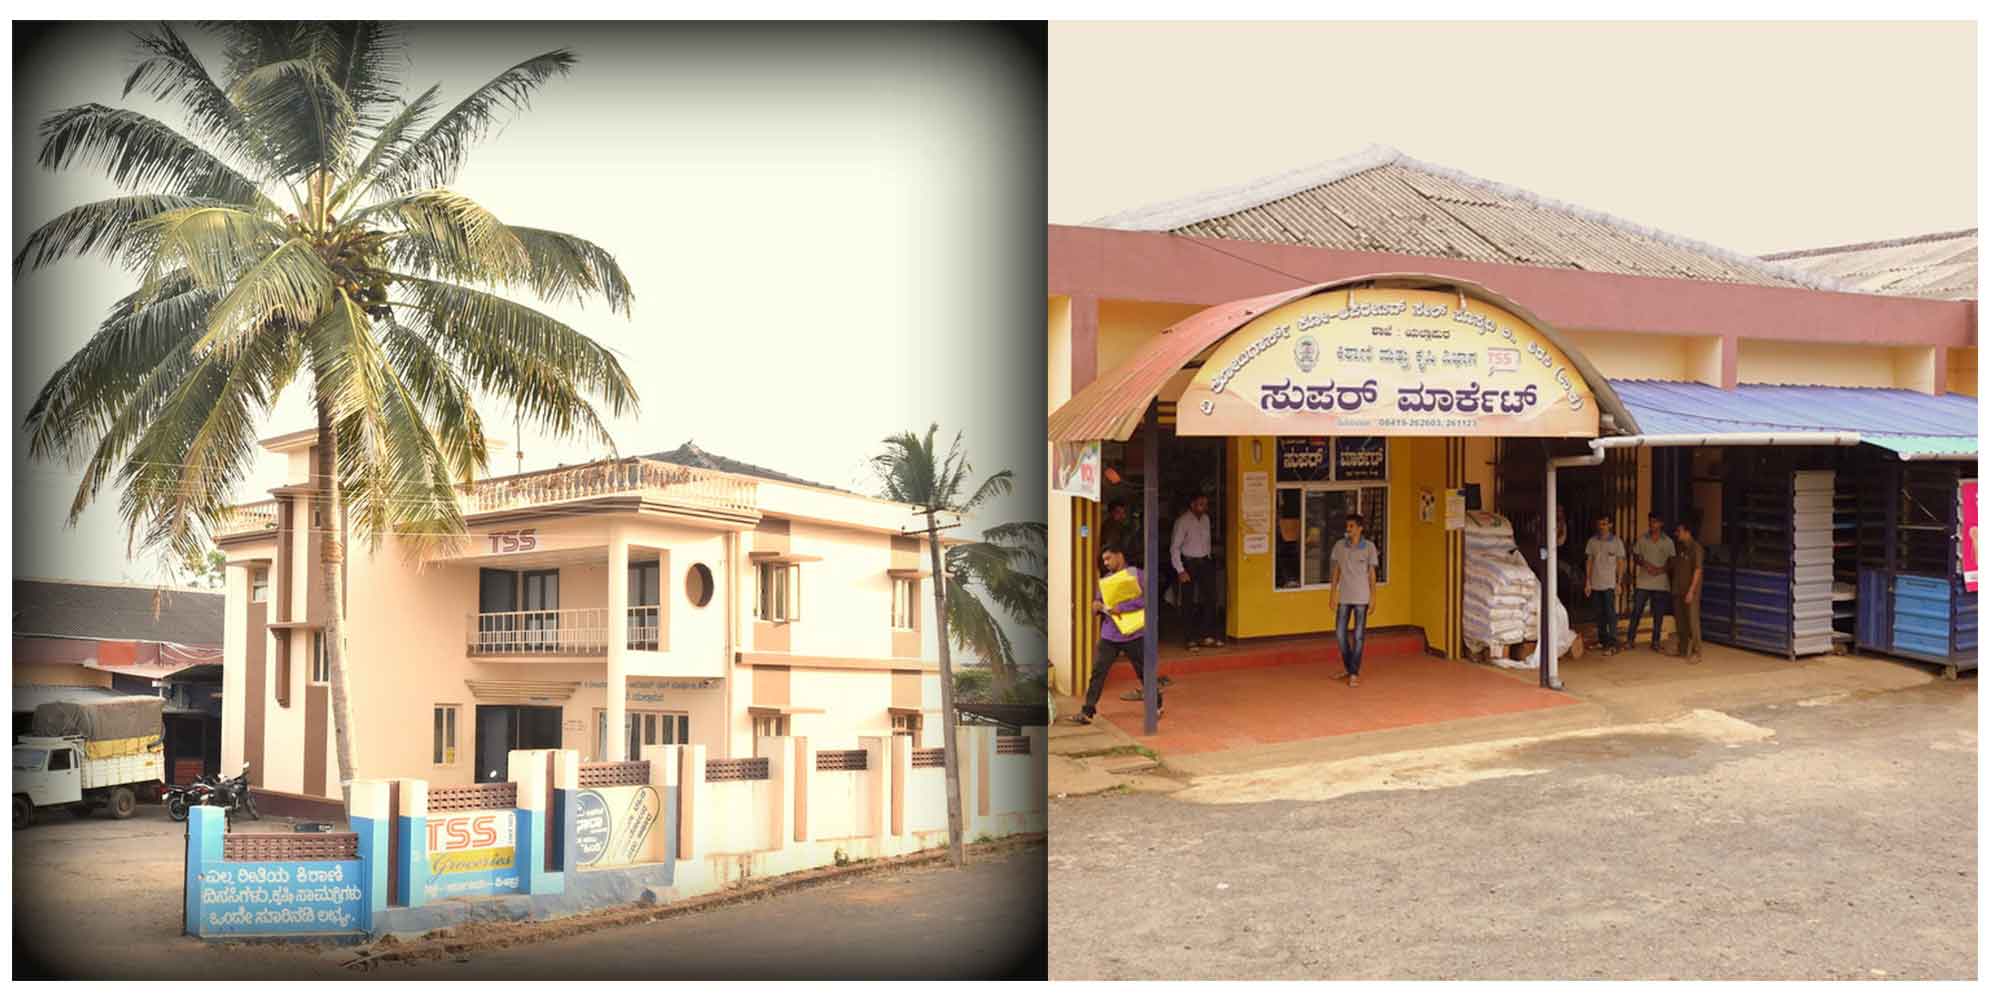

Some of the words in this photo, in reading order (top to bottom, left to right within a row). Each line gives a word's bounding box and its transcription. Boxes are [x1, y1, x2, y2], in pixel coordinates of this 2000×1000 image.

[1488, 351, 1513, 366] TSS
[1260, 376, 1378, 412] ಸುಪರ್
[1397, 380, 1537, 414] ಮಾರ್ಕೆಟ್
[487, 528, 537, 554] TSS
[426, 815, 497, 851] TSS
